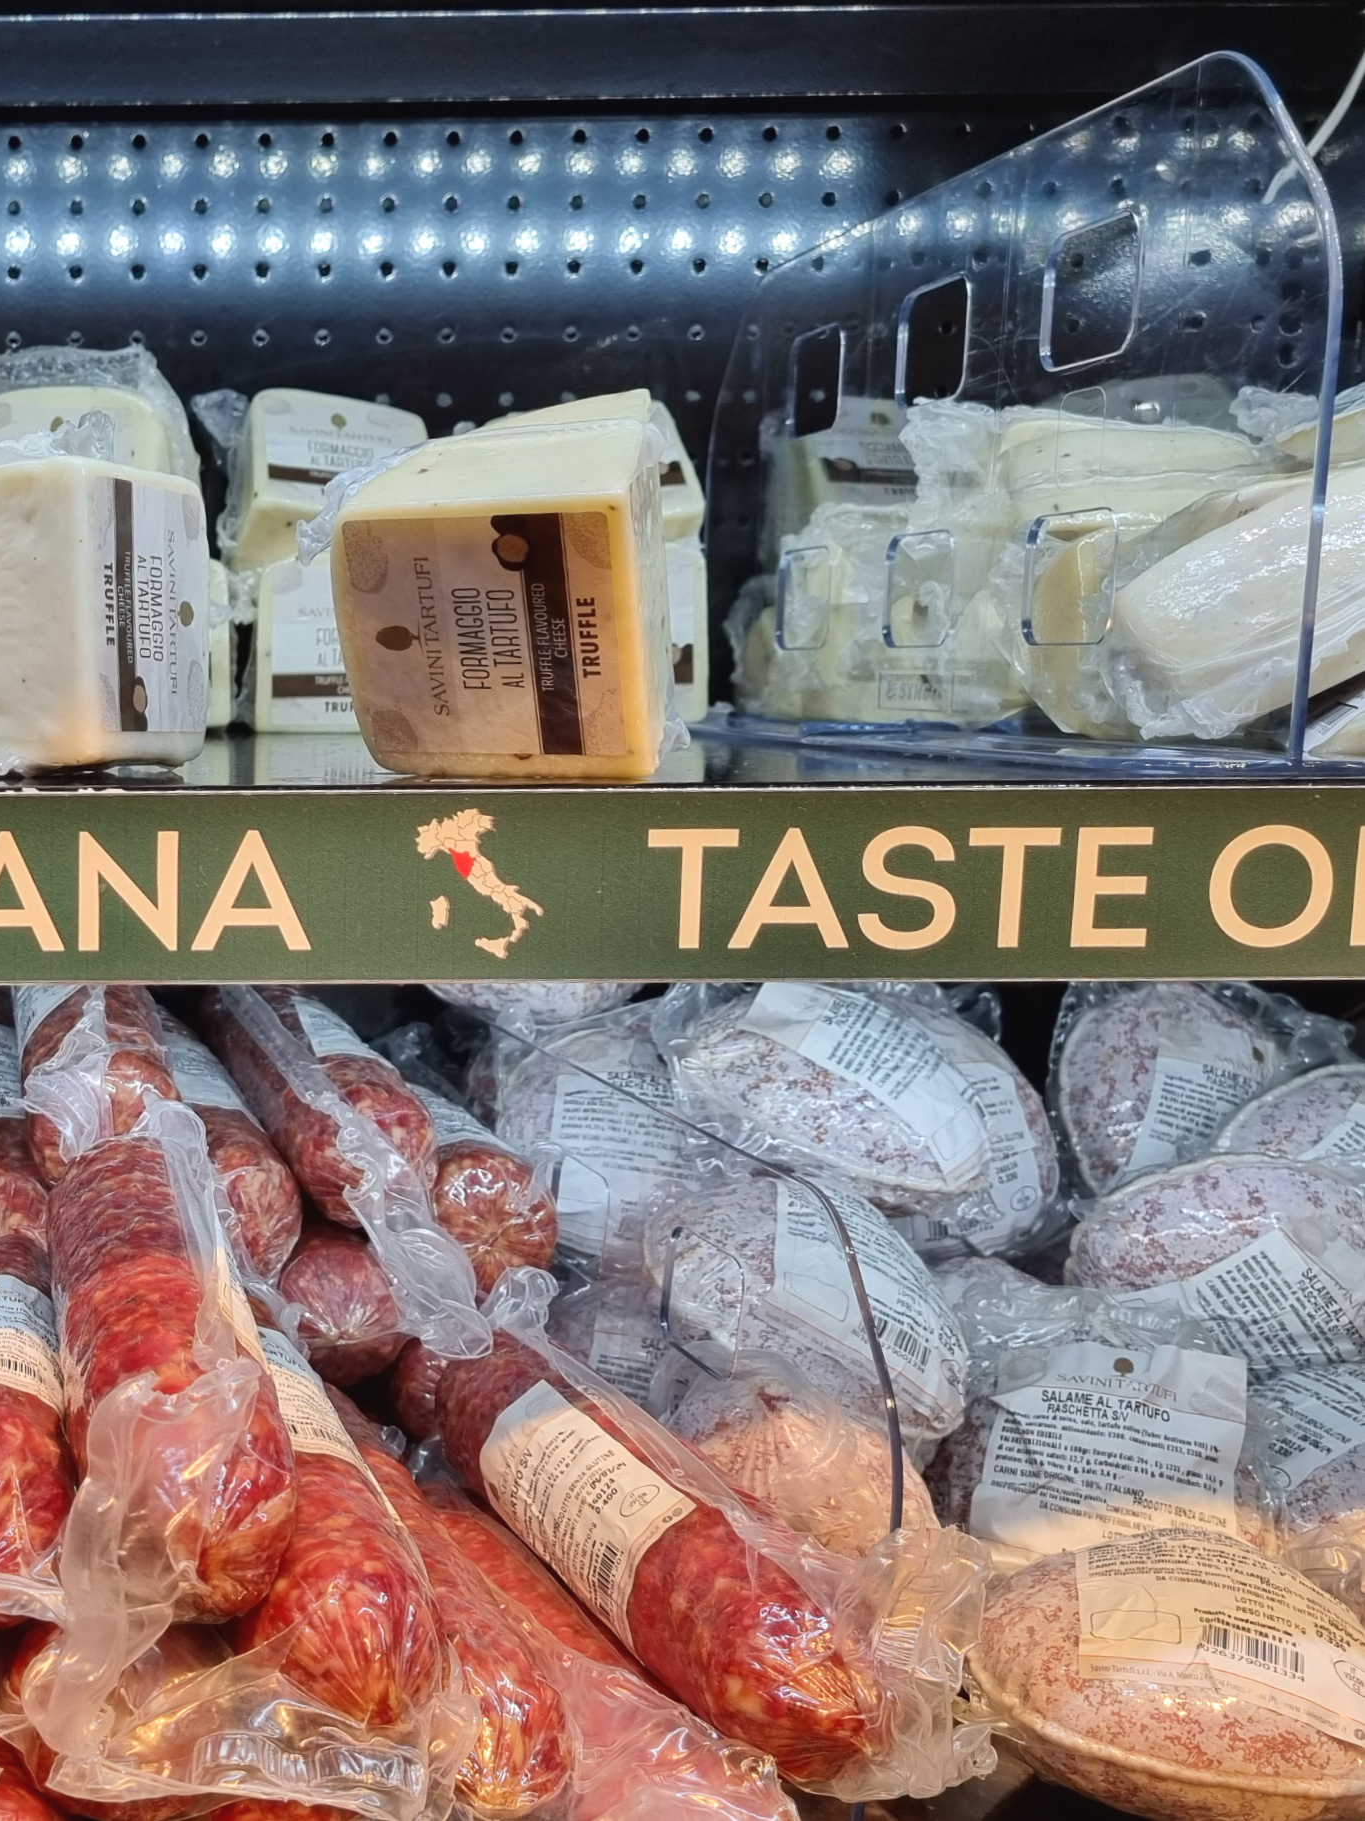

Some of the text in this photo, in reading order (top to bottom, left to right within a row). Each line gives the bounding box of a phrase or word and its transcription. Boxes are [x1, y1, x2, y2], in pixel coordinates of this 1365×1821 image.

[103, 562, 115, 646] TRUFFLE
[124, 551, 133, 664] TRUFFLE-FLAVOURED
[137, 555, 151, 659] AL TARTUFO
[150, 555, 164, 662] FORMAGGIO
[451, 587, 491, 690] FORMAGGIO
[486, 589, 525, 688] AL TARTUFO
[531, 583, 554, 692] TRUFFLE-FLAVOURED
[551, 617, 568, 658] CHEESE
[576, 597, 601, 678] TRUFFLE
[648, 825, 1365, 949] TASTE O
[1041, 1389, 1171, 1422] SALAME AL TARTUFO
[1047, 1403, 1129, 1422] FIASCHETTA S/V
[585, 1449, 616, 1471] GLUTINE
[994, 1465, 1018, 1475] CARNI
[1020, 1469, 1042, 1479] SUINE
[1105, 1483, 1145, 1497] ITALIANO
[1039, 1500, 1049, 1510] DA
[1049, 1503, 1094, 1520] CONSUMARSI
[1132, 1497, 1173, 1514] PRODOTTO
[1174, 1506, 1197, 1519] SENZA
[1199, 1512, 1228, 1528] GLUTINE
[1102, 1529, 1128, 1540] LOTT
[1225, 1567, 1270, 1582] ITALIANO
[1169, 1576, 1220, 1588] CONSUMARSI
[1222, 1584, 1291, 1608] PREFERIBILMENTE
[1235, 1595, 1265, 1608] LOTTO
[1199, 1616, 1269, 1639] CONSERVARE TRA
[1235, 1606, 1260, 1617] PESO
[1263, 1612, 1293, 1628] NETTO
[1090, 1664, 1111, 1672] Savini
[1112, 1665, 1135, 1674] Tartufi
